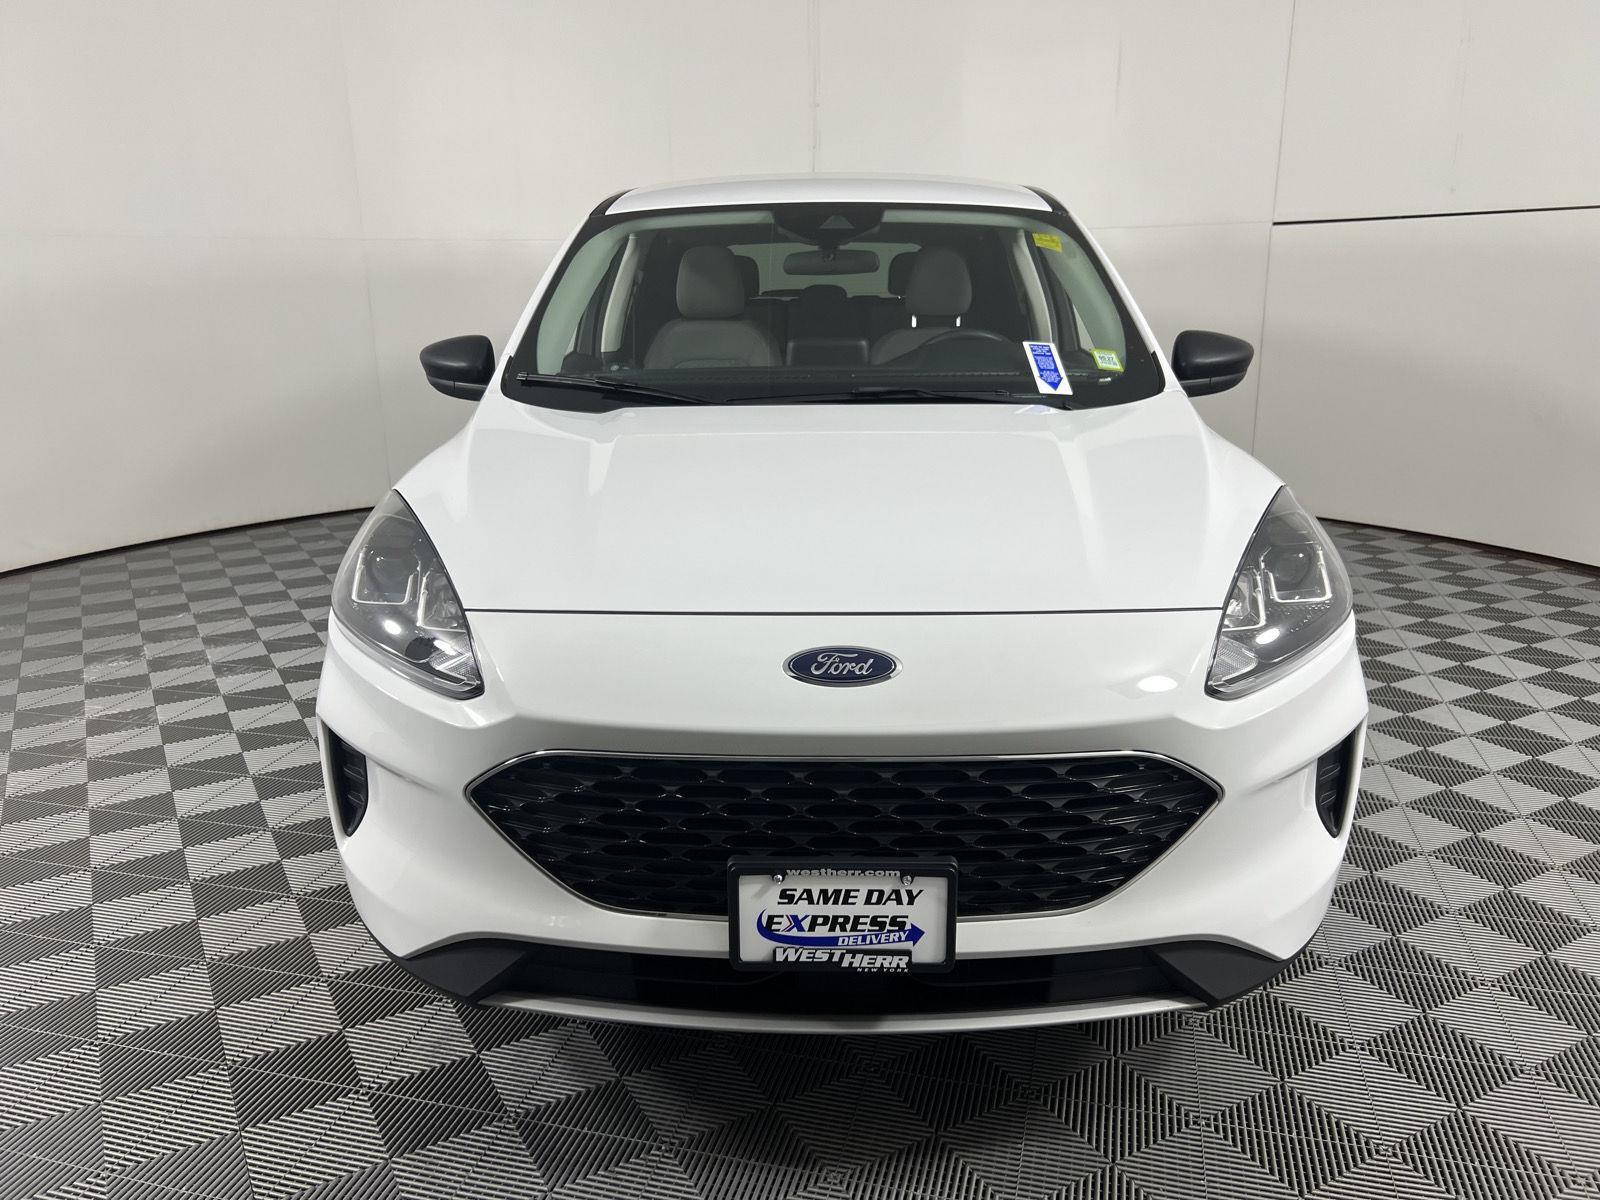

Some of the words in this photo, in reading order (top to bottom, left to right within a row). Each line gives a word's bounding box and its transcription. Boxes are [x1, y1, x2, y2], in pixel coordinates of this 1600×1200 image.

[811, 652, 874, 675] Ford
[787, 868, 900, 877] westherr.com
[778, 888, 859, 905] SAME
[865, 888, 924, 905] DAY
[766, 914, 910, 932] EXPRESS
[838, 931, 908, 946] DELIVERY
